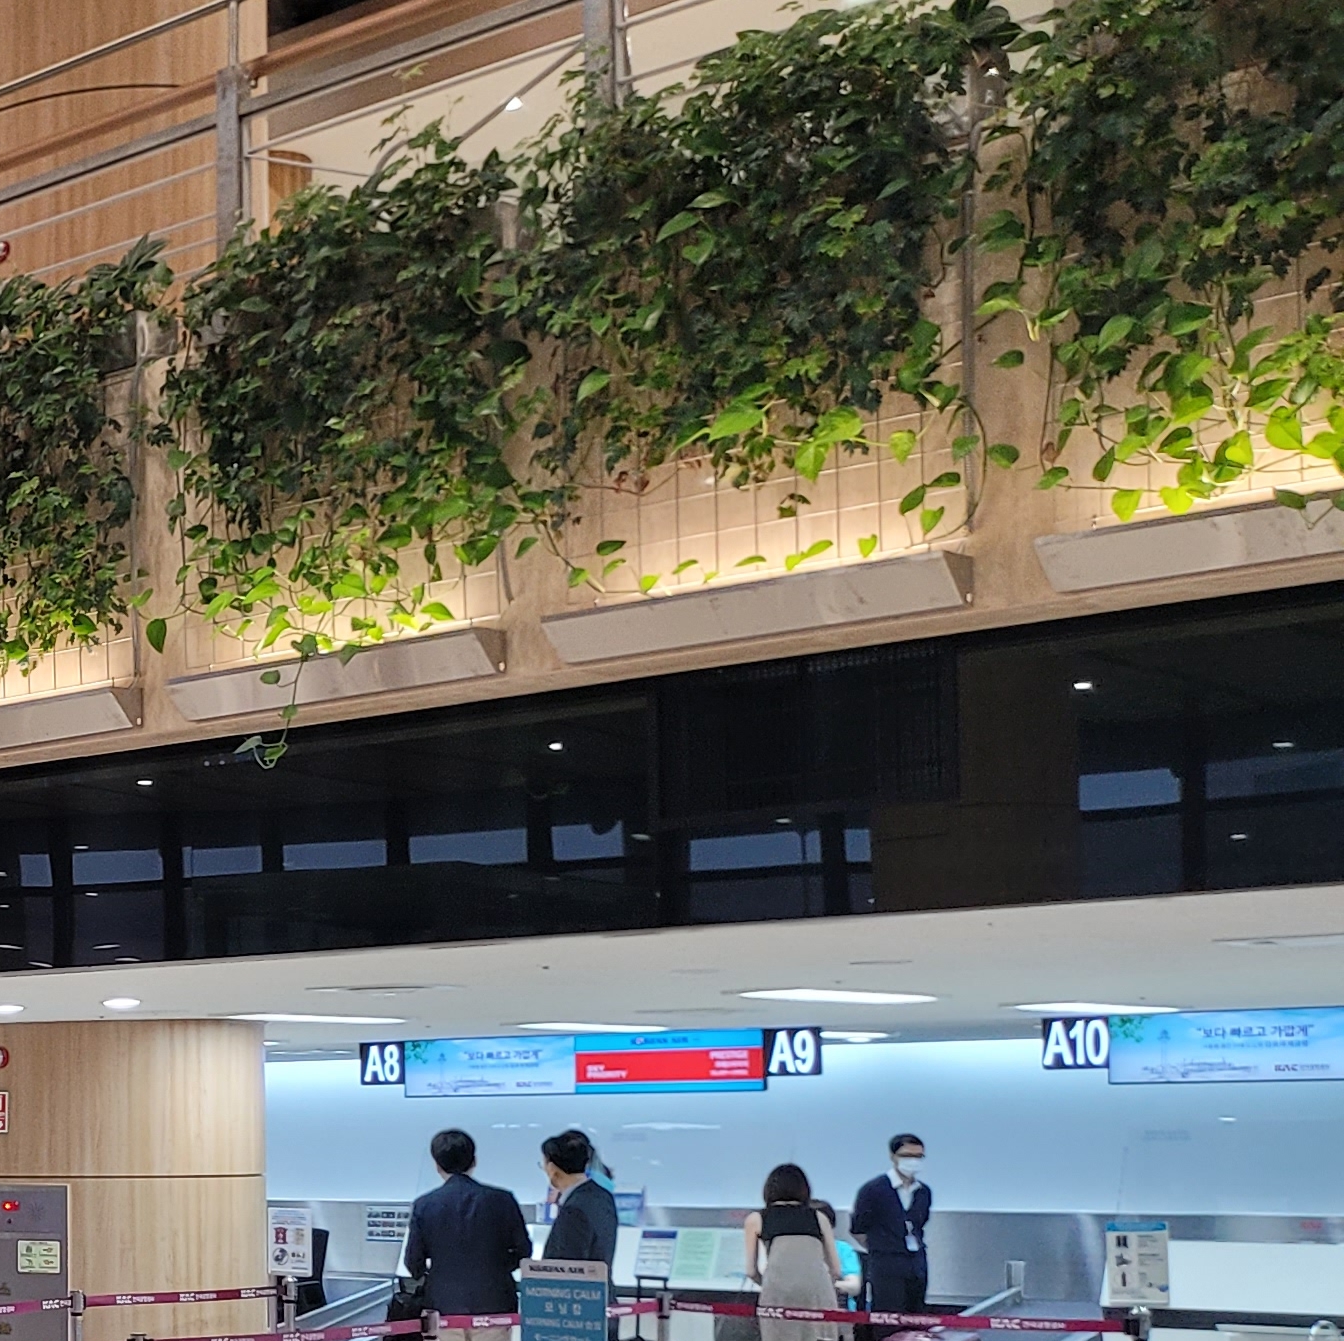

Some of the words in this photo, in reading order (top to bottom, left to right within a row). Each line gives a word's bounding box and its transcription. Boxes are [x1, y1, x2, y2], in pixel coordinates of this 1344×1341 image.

[768, 1030, 814, 1073] A9
[1044, 1019, 1109, 1066] A10
[364, 1044, 400, 1082] A8
[573, 1290, 601, 1299] CALM
